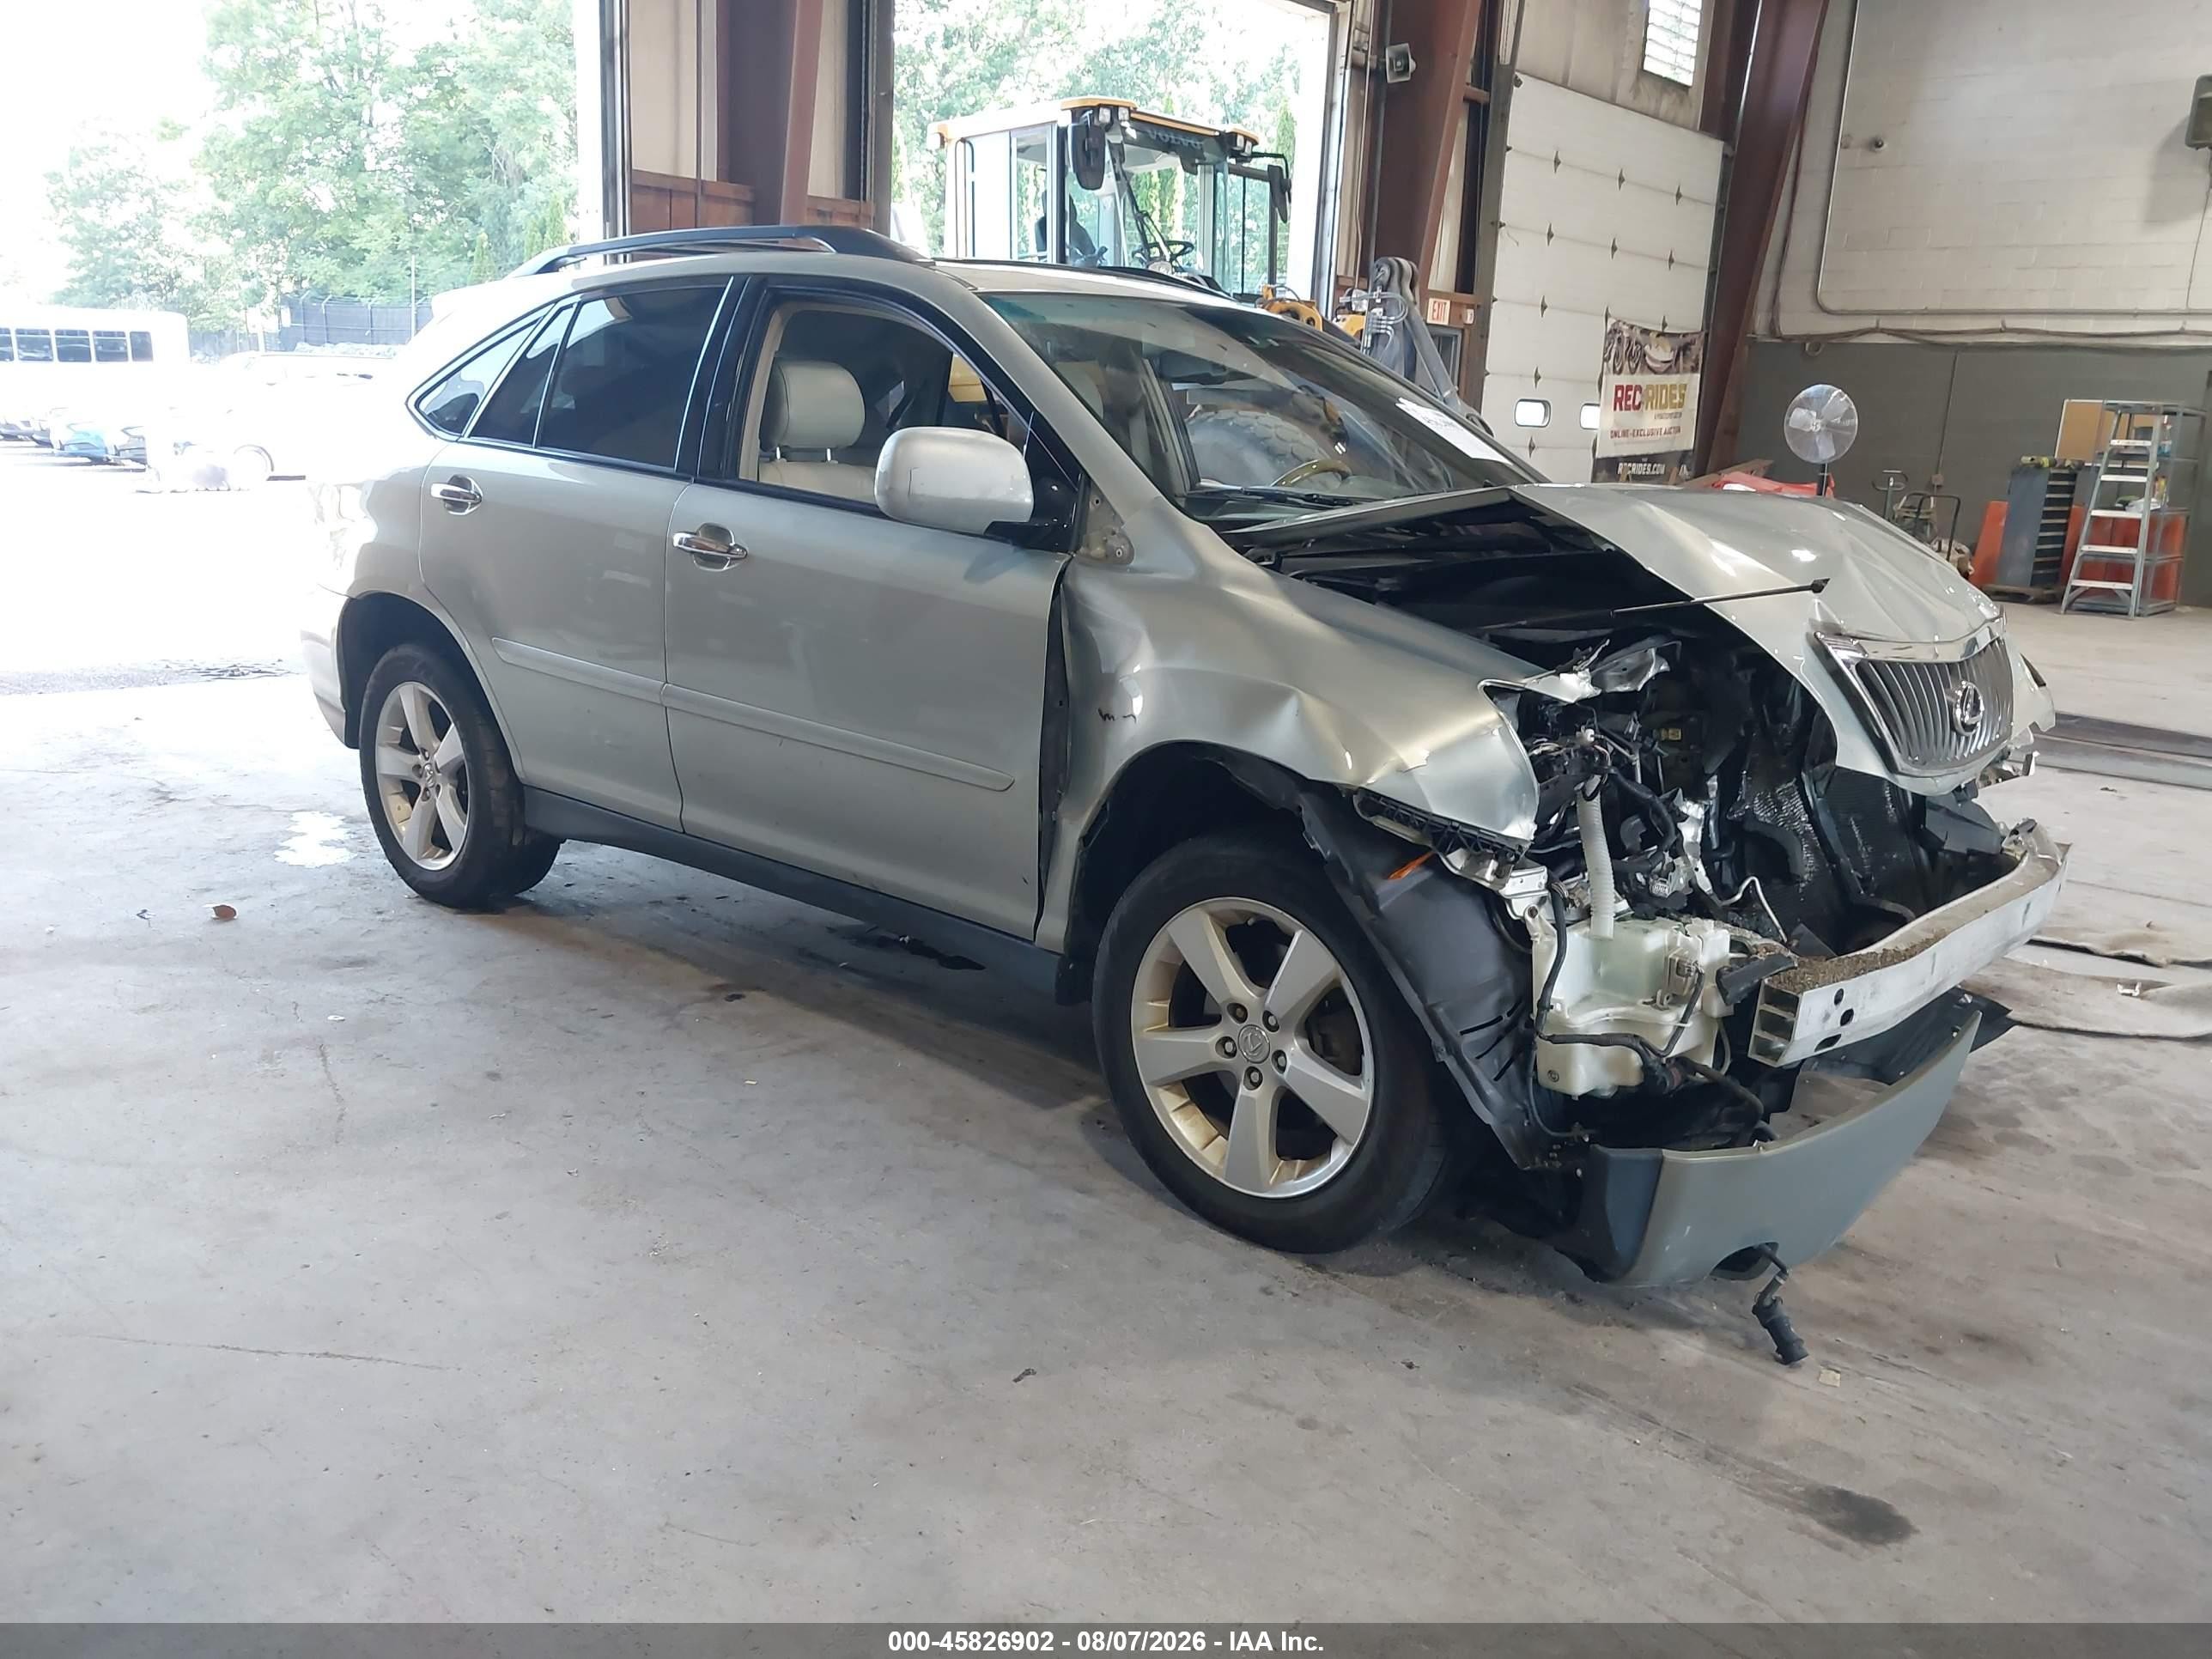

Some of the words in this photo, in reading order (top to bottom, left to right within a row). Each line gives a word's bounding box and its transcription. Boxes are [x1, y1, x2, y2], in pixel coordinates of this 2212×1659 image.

[1147, 130, 1202, 149] VOLVO
[1432, 301, 1447, 322] EXIT
[1613, 385, 1643, 411] REC
[1645, 384, 1687, 410] RIDES
